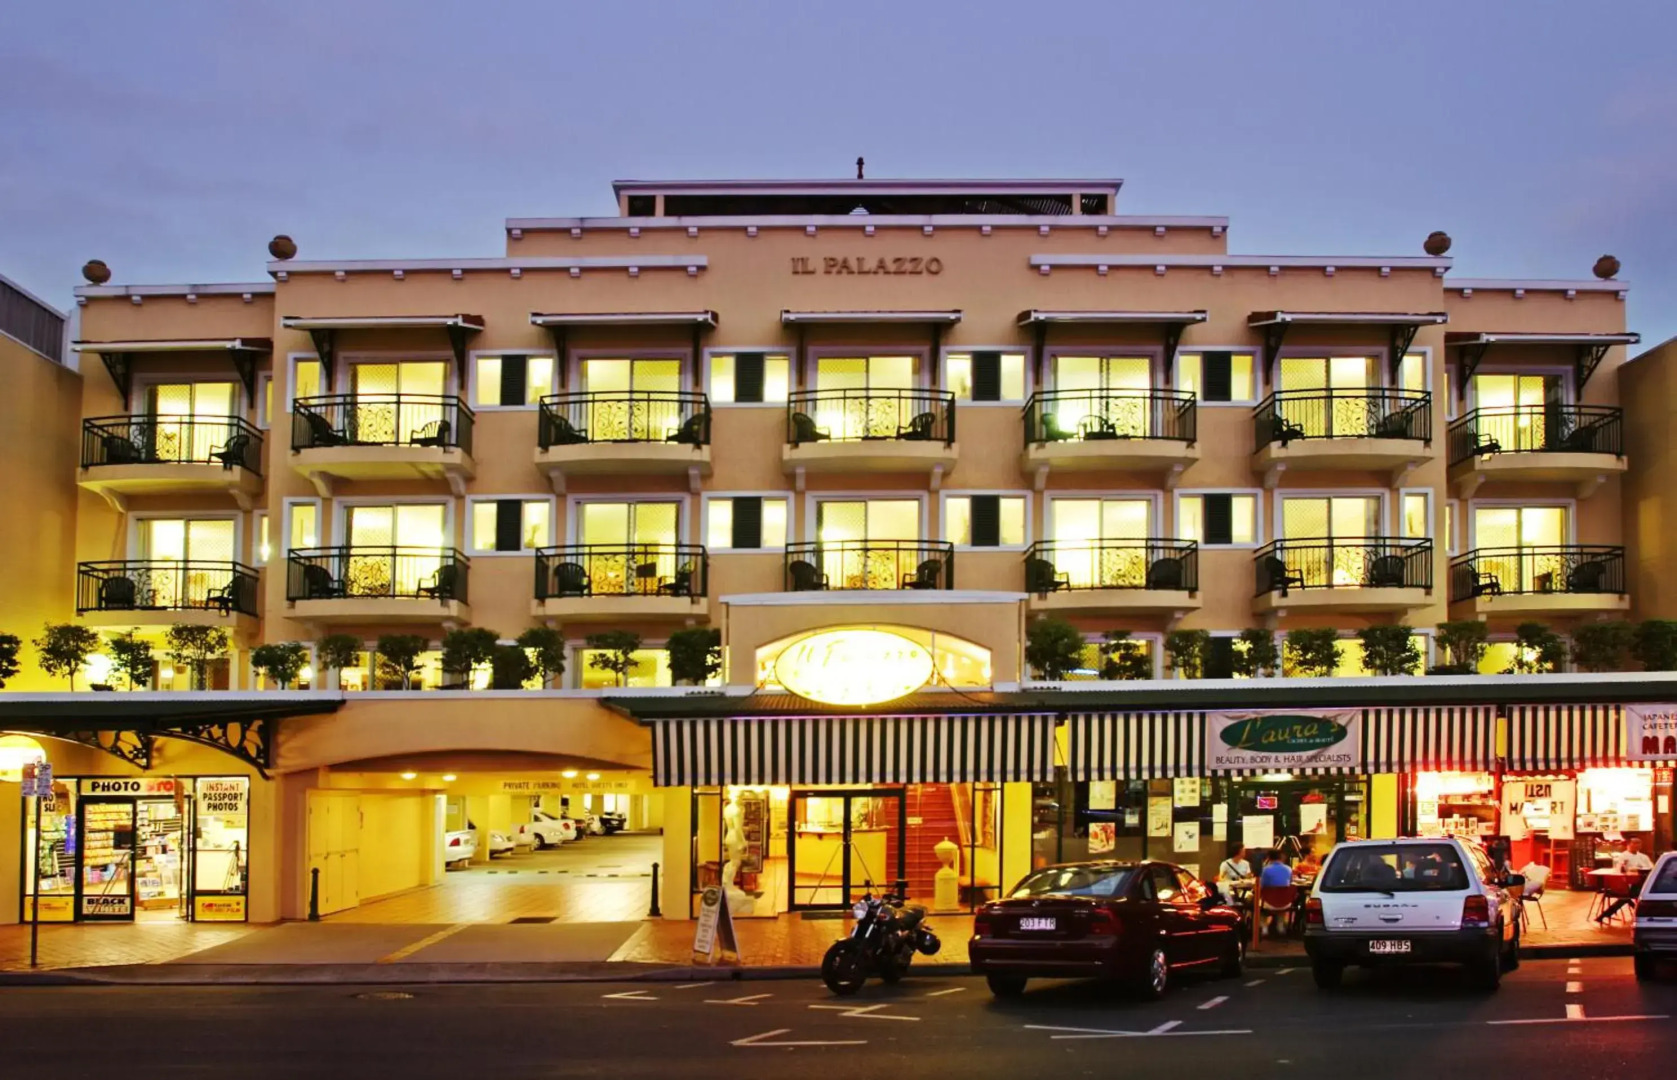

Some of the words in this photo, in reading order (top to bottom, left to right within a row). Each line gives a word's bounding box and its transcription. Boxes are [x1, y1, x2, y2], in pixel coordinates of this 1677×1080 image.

[791, 257, 816, 275] IL
[823, 257, 943, 275] PALAZZO
[1643, 713, 1677, 721] JAPANE
[1250, 755, 1272, 763] BODY
[1274, 755, 1281, 763] &
[1283, 754, 1303, 763] HAIR
[91, 781, 141, 792] PHOTO
[206, 782, 240, 791] INSTANT
[203, 792, 244, 802] PASSPORT
[207, 802, 239, 812] PHOTOS
